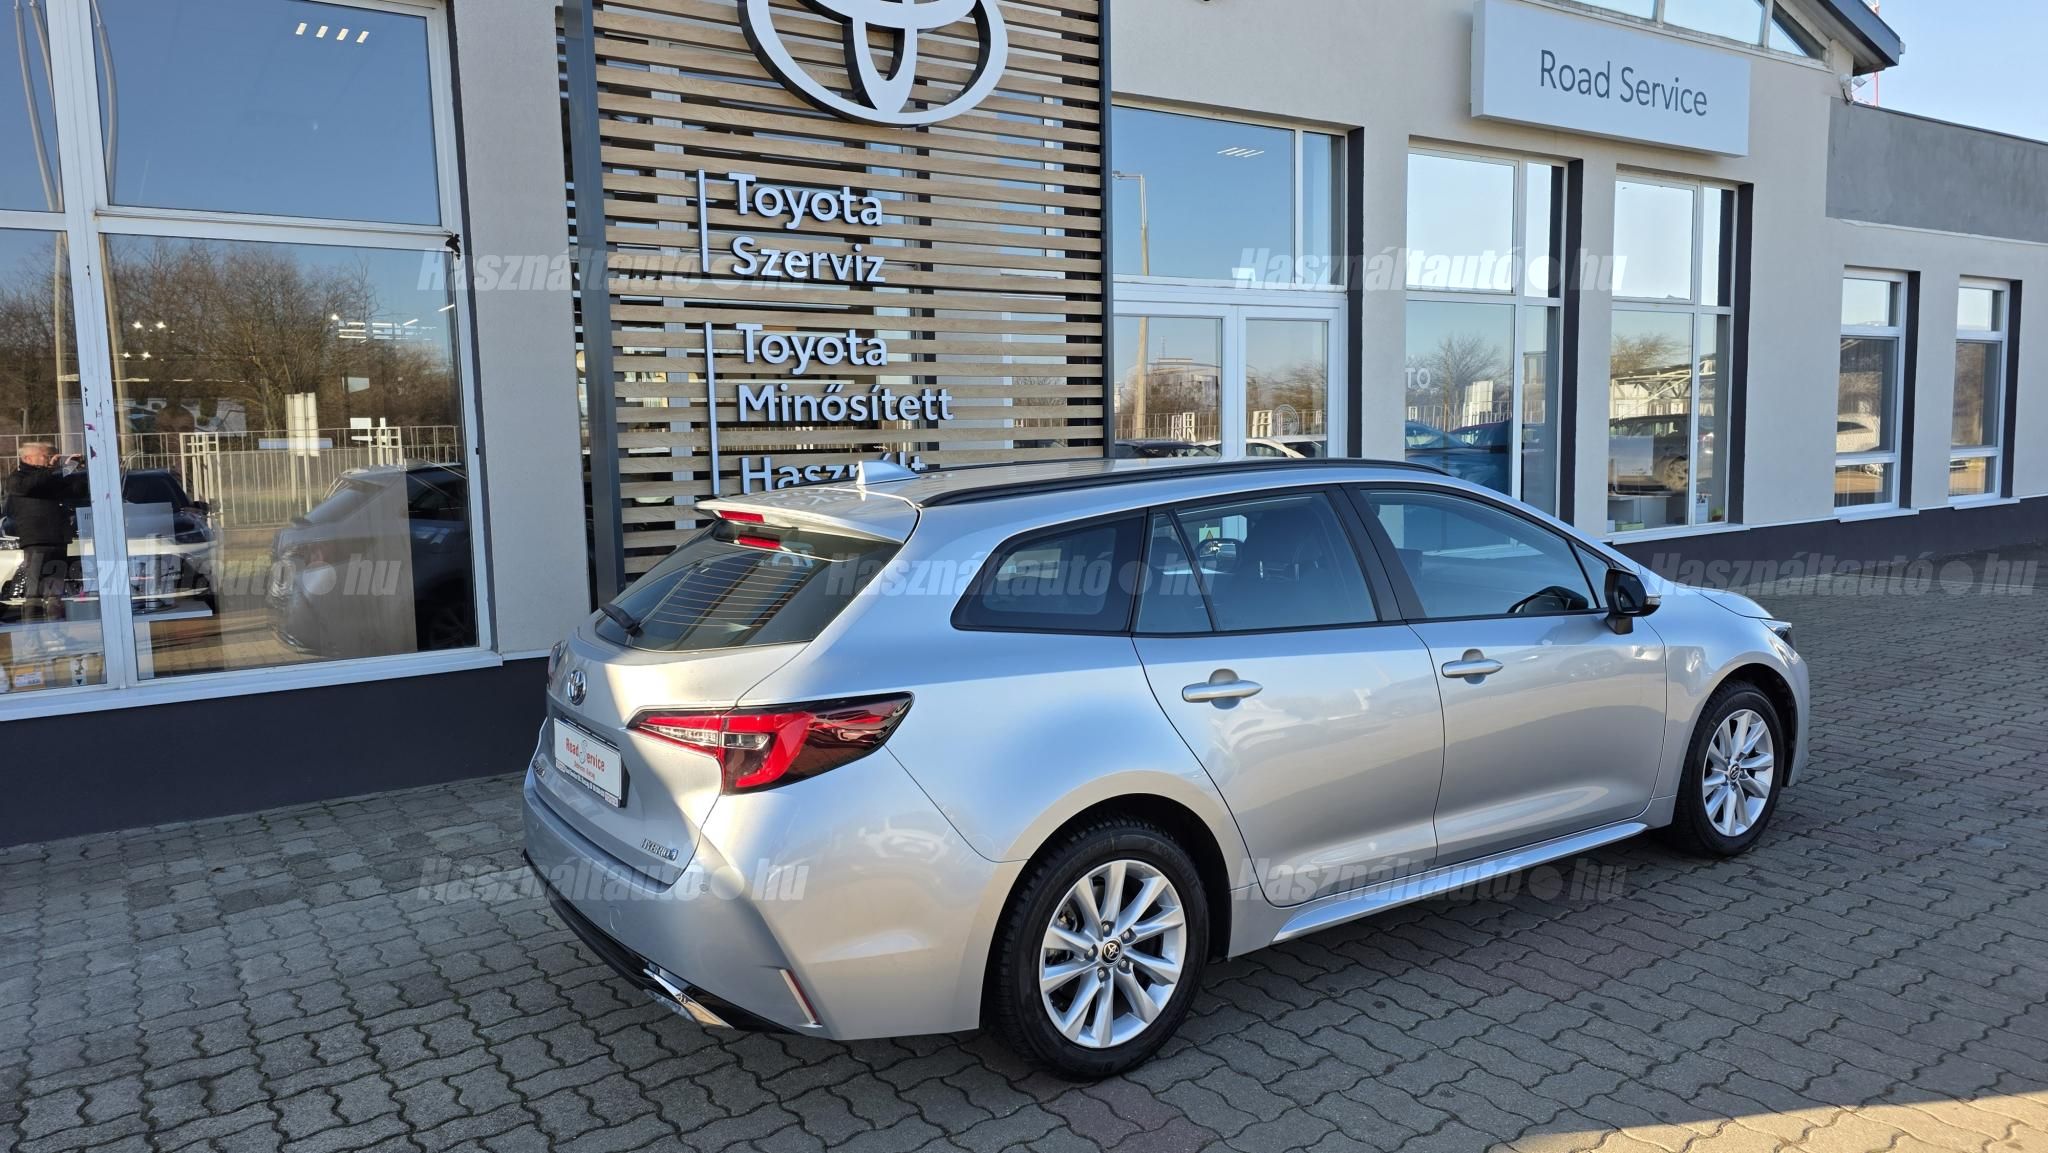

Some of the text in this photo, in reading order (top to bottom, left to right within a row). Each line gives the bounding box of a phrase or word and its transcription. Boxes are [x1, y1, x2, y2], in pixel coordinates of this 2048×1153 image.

[1540, 49, 1707, 116] Road Service
[728, 171, 883, 229] Toyota
[731, 235, 886, 282] Szerviz
[735, 322, 888, 375] Toyota
[737, 383, 954, 422] Minősített
[740, 451, 928, 495] Haszlt
